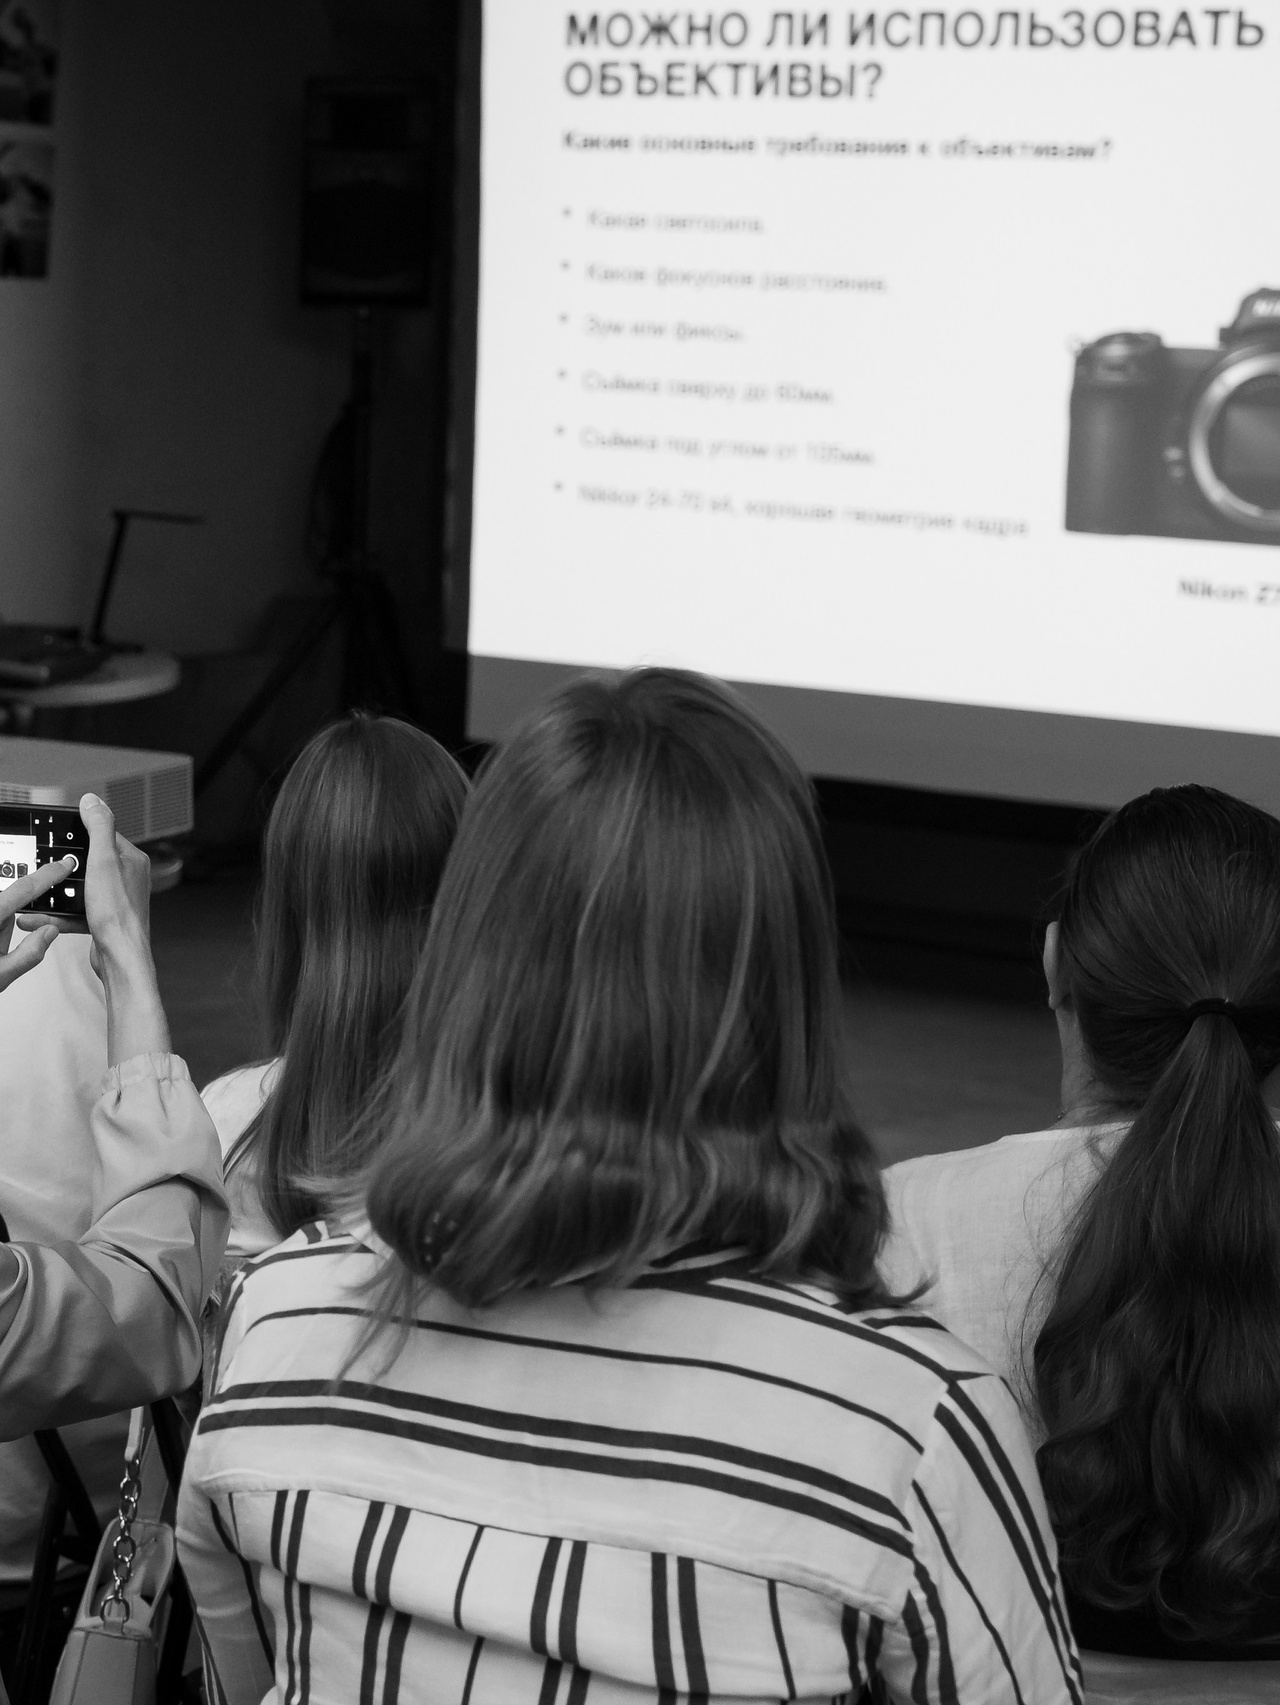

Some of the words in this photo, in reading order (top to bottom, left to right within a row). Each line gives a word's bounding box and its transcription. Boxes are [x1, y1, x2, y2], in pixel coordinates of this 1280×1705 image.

[565, 10, 750, 48] МОЖНО
[764, 10, 830, 48] ЛИ
[847, 8, 1266, 49] ИСПОЛЬЗОВАТЬ
[563, 60, 884, 99] ОБЪЕКТИВЫ?
[561, 130, 632, 153] Какие
[638, 135, 758, 155] основные
[764, 134, 911, 159] требования
[939, 136, 1114, 161] объективам?
[1178, 578, 1248, 603] Nikon
